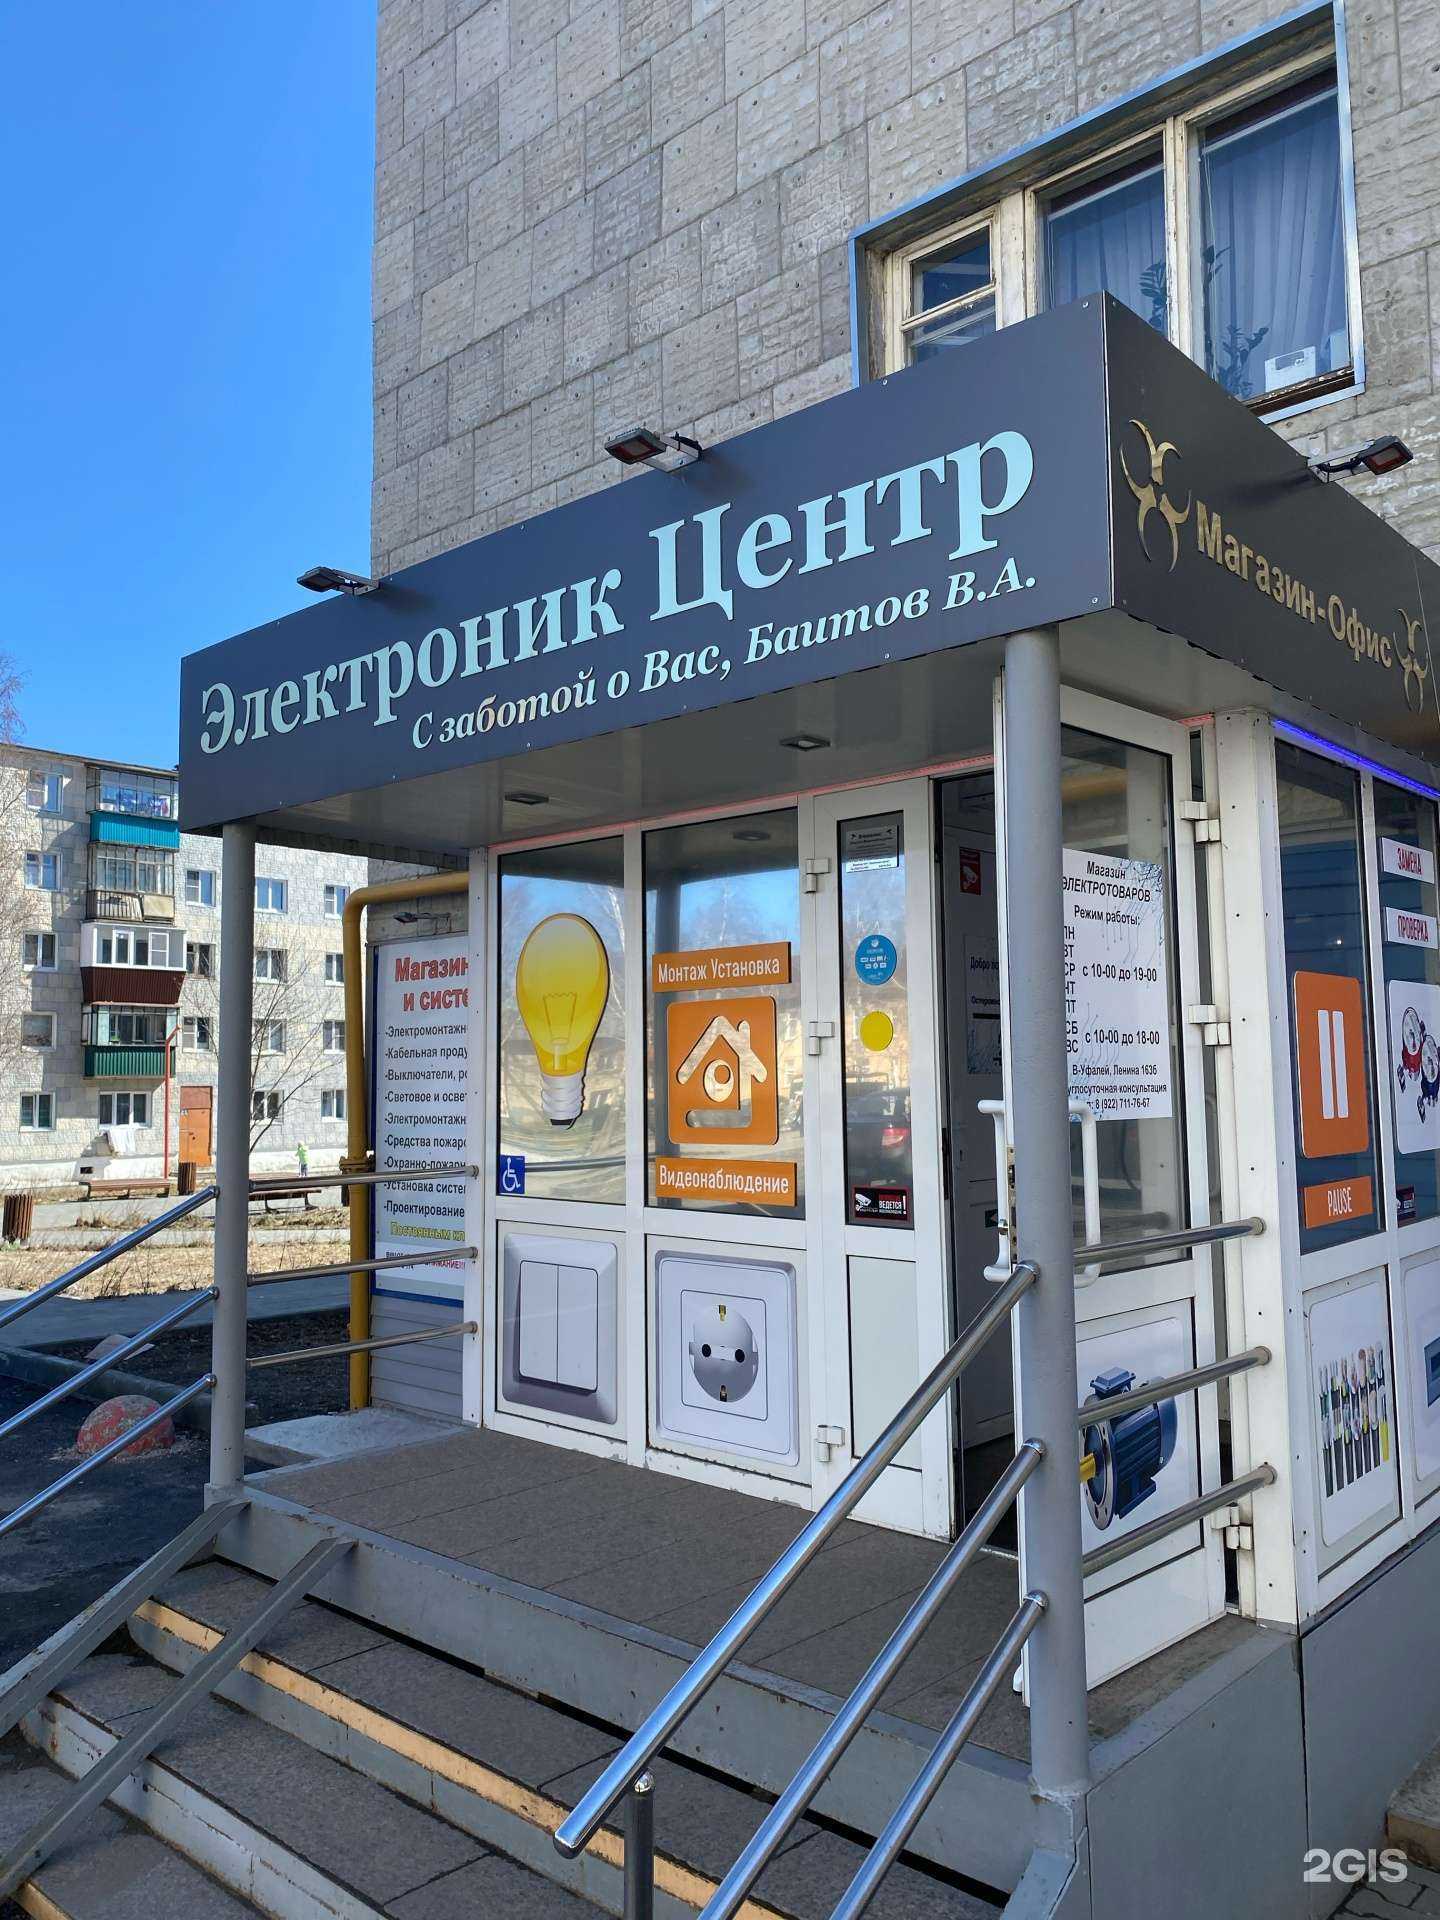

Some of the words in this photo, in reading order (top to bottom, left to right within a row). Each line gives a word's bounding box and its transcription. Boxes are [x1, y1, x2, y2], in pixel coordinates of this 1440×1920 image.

[200, 568, 625, 754] Электроник
[648, 430, 1034, 621] Центр
[1195, 499, 1393, 669] Магазин-Офис
[412, 711, 433, 749] С
[438, 666, 598, 743] заботой
[606, 670, 630, 699] о
[638, 645, 731, 693] Вас,
[743, 588, 930, 664] Баитов
[942, 557, 1036, 610] В.А.
[1086, 860, 1126, 880] Магазин
[1397, 847, 1422, 875] ЗАМЕНА
[1074, 904, 1104, 921] Режим
[1105, 910, 1141, 926] работы:
[1397, 914, 1429, 942] ПРОВЕРКА
[658, 963, 707, 983] Монтаж
[711, 957, 780, 979] Установка
[1082, 965, 1089, 977] с
[1091, 963, 1117, 979] 10-00
[1118, 968, 1131, 982] до
[1133, 966, 1157, 982] 19-00
[403, 993, 415, 1012] и
[1085, 1032, 1091, 1043] с
[1094, 1028, 1119, 1044] 10-00
[1121, 1033, 1134, 1046] до
[1136, 1030, 1160, 1045] 18-00
[385, 1047, 438, 1060] -Кабельная
[385, 1069, 456, 1081] -Выключатели,
[1072, 1064, 1112, 1077] В-Уфалей,
[1113, 1064, 1140, 1076] Ленина
[385, 1091, 431, 1103] -Световое
[433, 1092, 440, 1102] и
[442, 1091, 468, 1102] осве
[1119, 1083, 1167, 1095] консультация
[1095, 1098, 1100, 1110] 8
[1101, 1098, 1118, 1111] (922)
[1119, 1097, 1150, 1109] 711-76-67
[384, 1134, 431, 1150] -Средства
[659, 1165, 789, 1194] Видеонаблюдение
[1327, 1186, 1353, 1217] PAUSE
